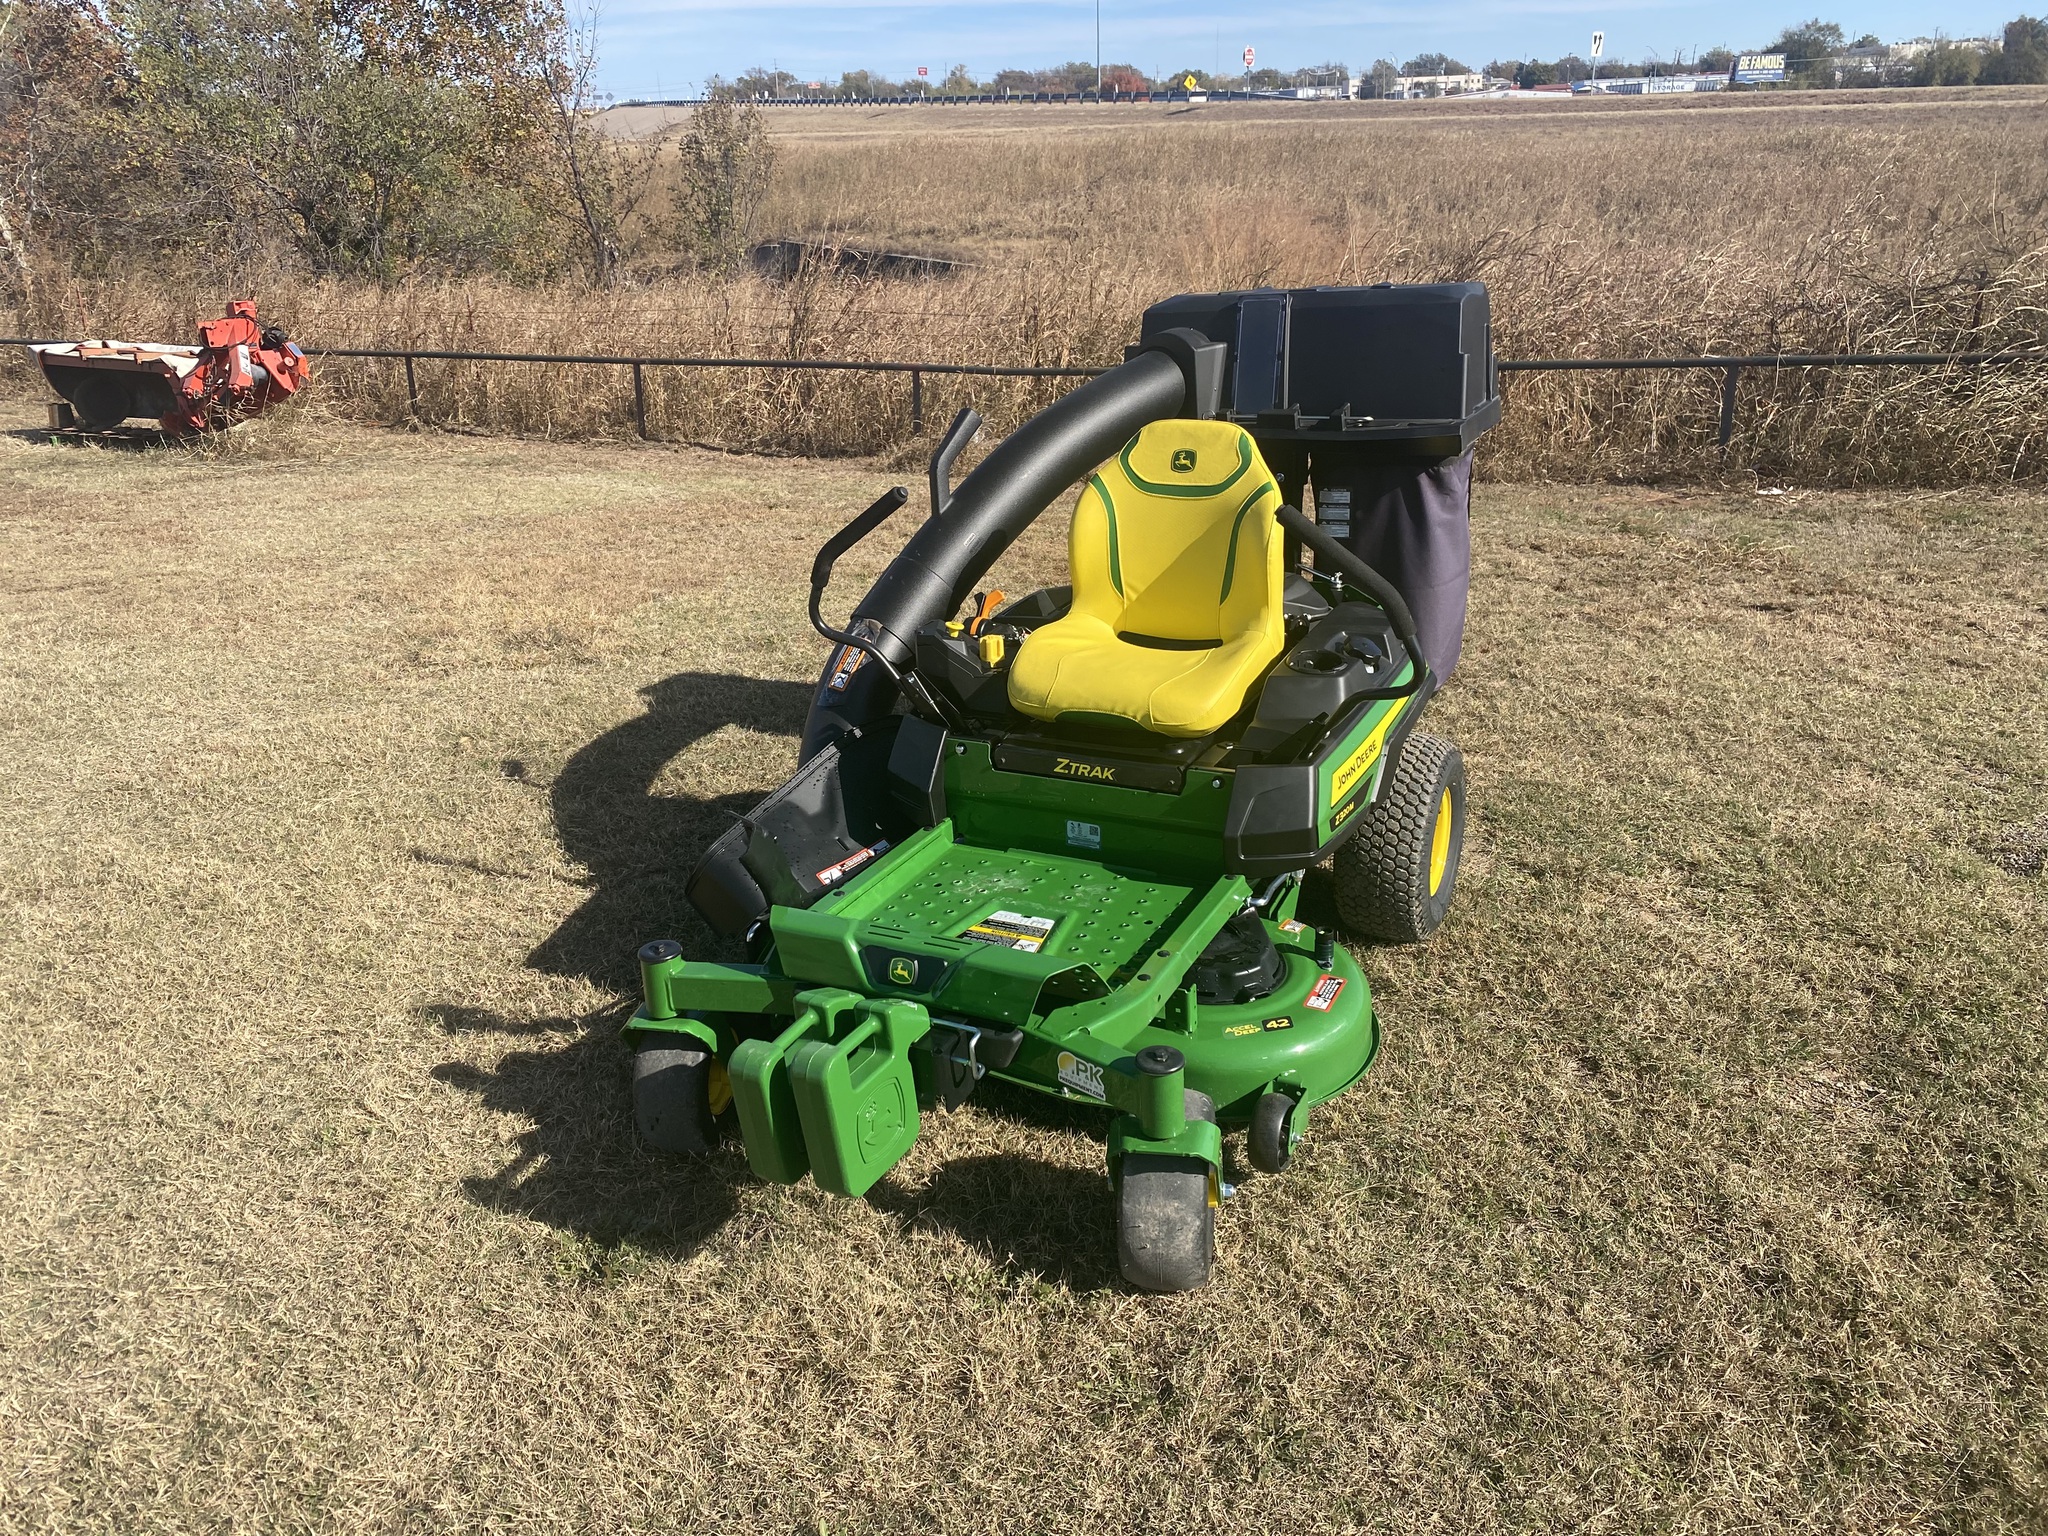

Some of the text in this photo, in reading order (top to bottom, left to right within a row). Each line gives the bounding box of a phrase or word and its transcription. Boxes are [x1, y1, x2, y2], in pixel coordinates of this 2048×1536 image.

[1738, 55, 1785, 70] BE FAMOUS
[1338, 740, 1378, 789] JOHN DEERE
[1266, 1019, 1290, 1028] 42
[1225, 1024, 1256, 1033] ACCEL
[1234, 1027, 1261, 1036] DEEP
